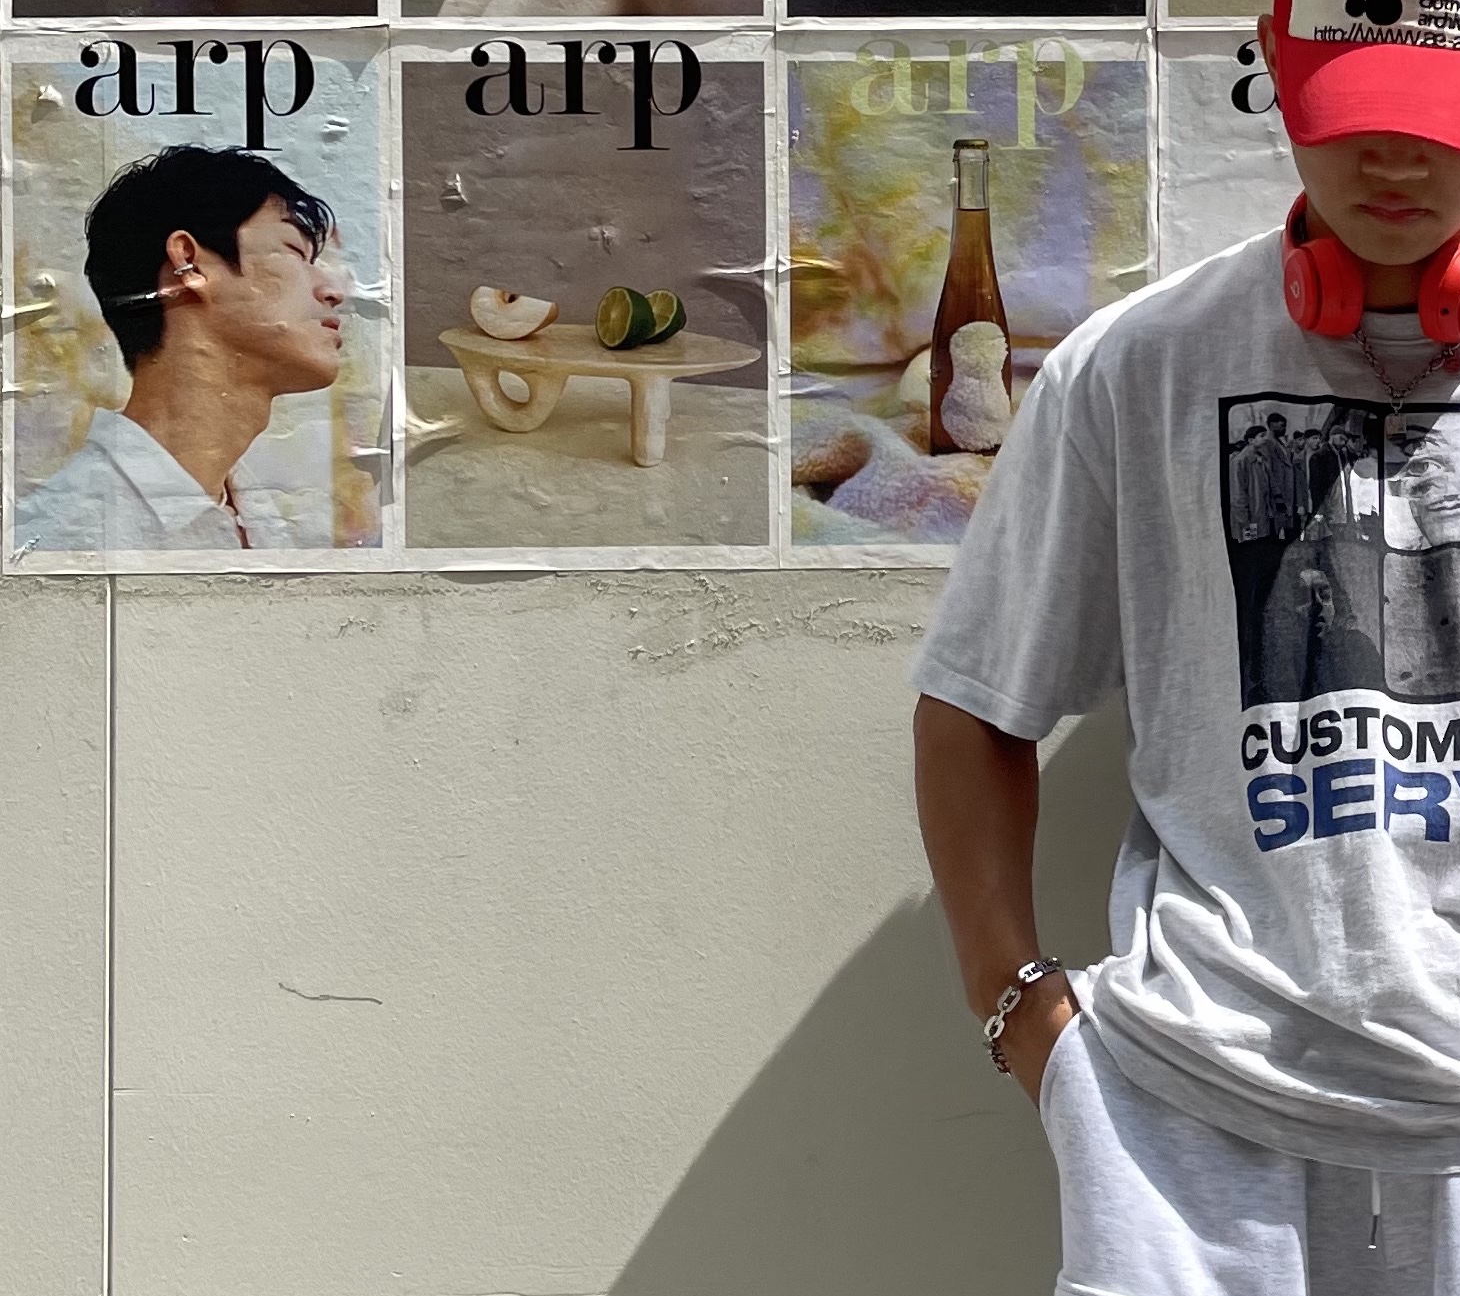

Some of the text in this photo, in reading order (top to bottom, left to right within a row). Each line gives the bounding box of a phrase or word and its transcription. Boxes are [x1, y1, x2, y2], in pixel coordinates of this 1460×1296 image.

[75, 39, 315, 151] arp
[465, 39, 702, 151] arp
[851, 36, 1085, 151] arp
